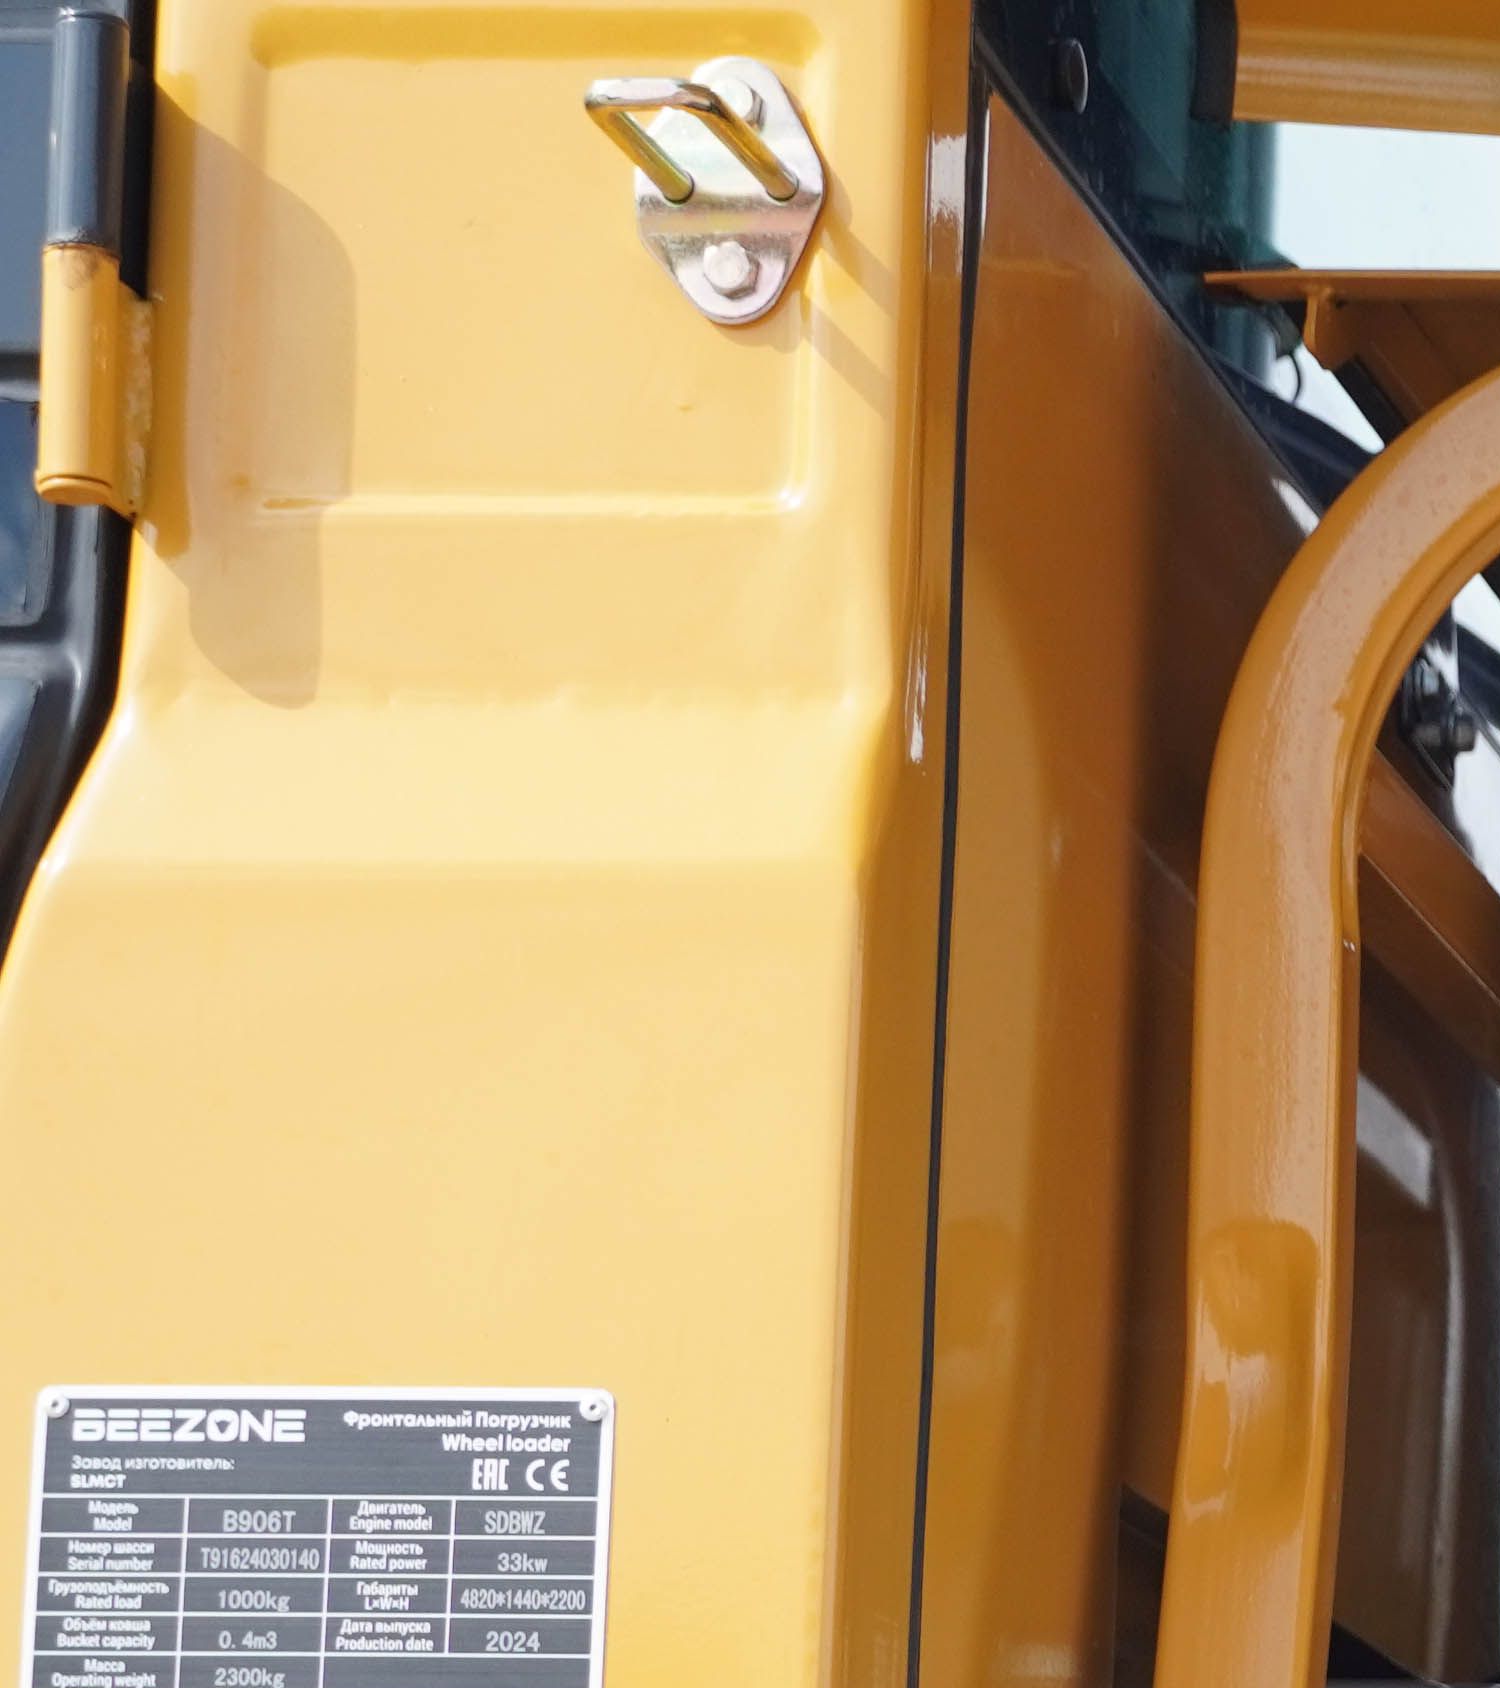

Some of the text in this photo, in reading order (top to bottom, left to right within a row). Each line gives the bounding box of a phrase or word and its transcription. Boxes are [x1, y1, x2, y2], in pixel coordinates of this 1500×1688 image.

[72, 1409, 306, 1442] BEEZONE
[343, 1410, 571, 1430] Фронтальный Погрузчик
[442, 1434, 571, 1452] Wheel loader
[125, 1456, 235, 1470] изготовитель:
[70, 1474, 126, 1488] SLMCT
[526, 1459, 569, 1491] CE
[88, 1500, 138, 1514] Модель
[357, 1501, 426, 1516] Двигатель
[93, 1517, 132, 1531] Model
[223, 1509, 296, 1533] B906T
[350, 1516, 432, 1532] Engine model
[484, 1511, 546, 1534] SDBWZ
[68, 1540, 155, 1556] Номер шасси
[355, 1541, 423, 1559] Мощность
[68, 1557, 153, 1571] Serial number
[201, 1548, 319, 1570] T91624030140
[350, 1556, 427, 1572] Rated power
[497, 1553, 548, 1573] 33kw
[357, 1582, 418, 1598] Габариты
[75, 1595, 142, 1610] Rated load
[218, 1590, 291, 1612] 1000kg
[63, 1617, 151, 1632] Объём ковша
[340, 1619, 431, 1638] Дата выпуска
[57, 1633, 155, 1650] Bucket capacity
[335, 1636, 434, 1652] Production date
[485, 1631, 541, 1652] 2024
[84, 1659, 126, 1673] Масса
[115, 1673, 156, 1688] weight
[214, 1668, 286, 1688] 2300kg
